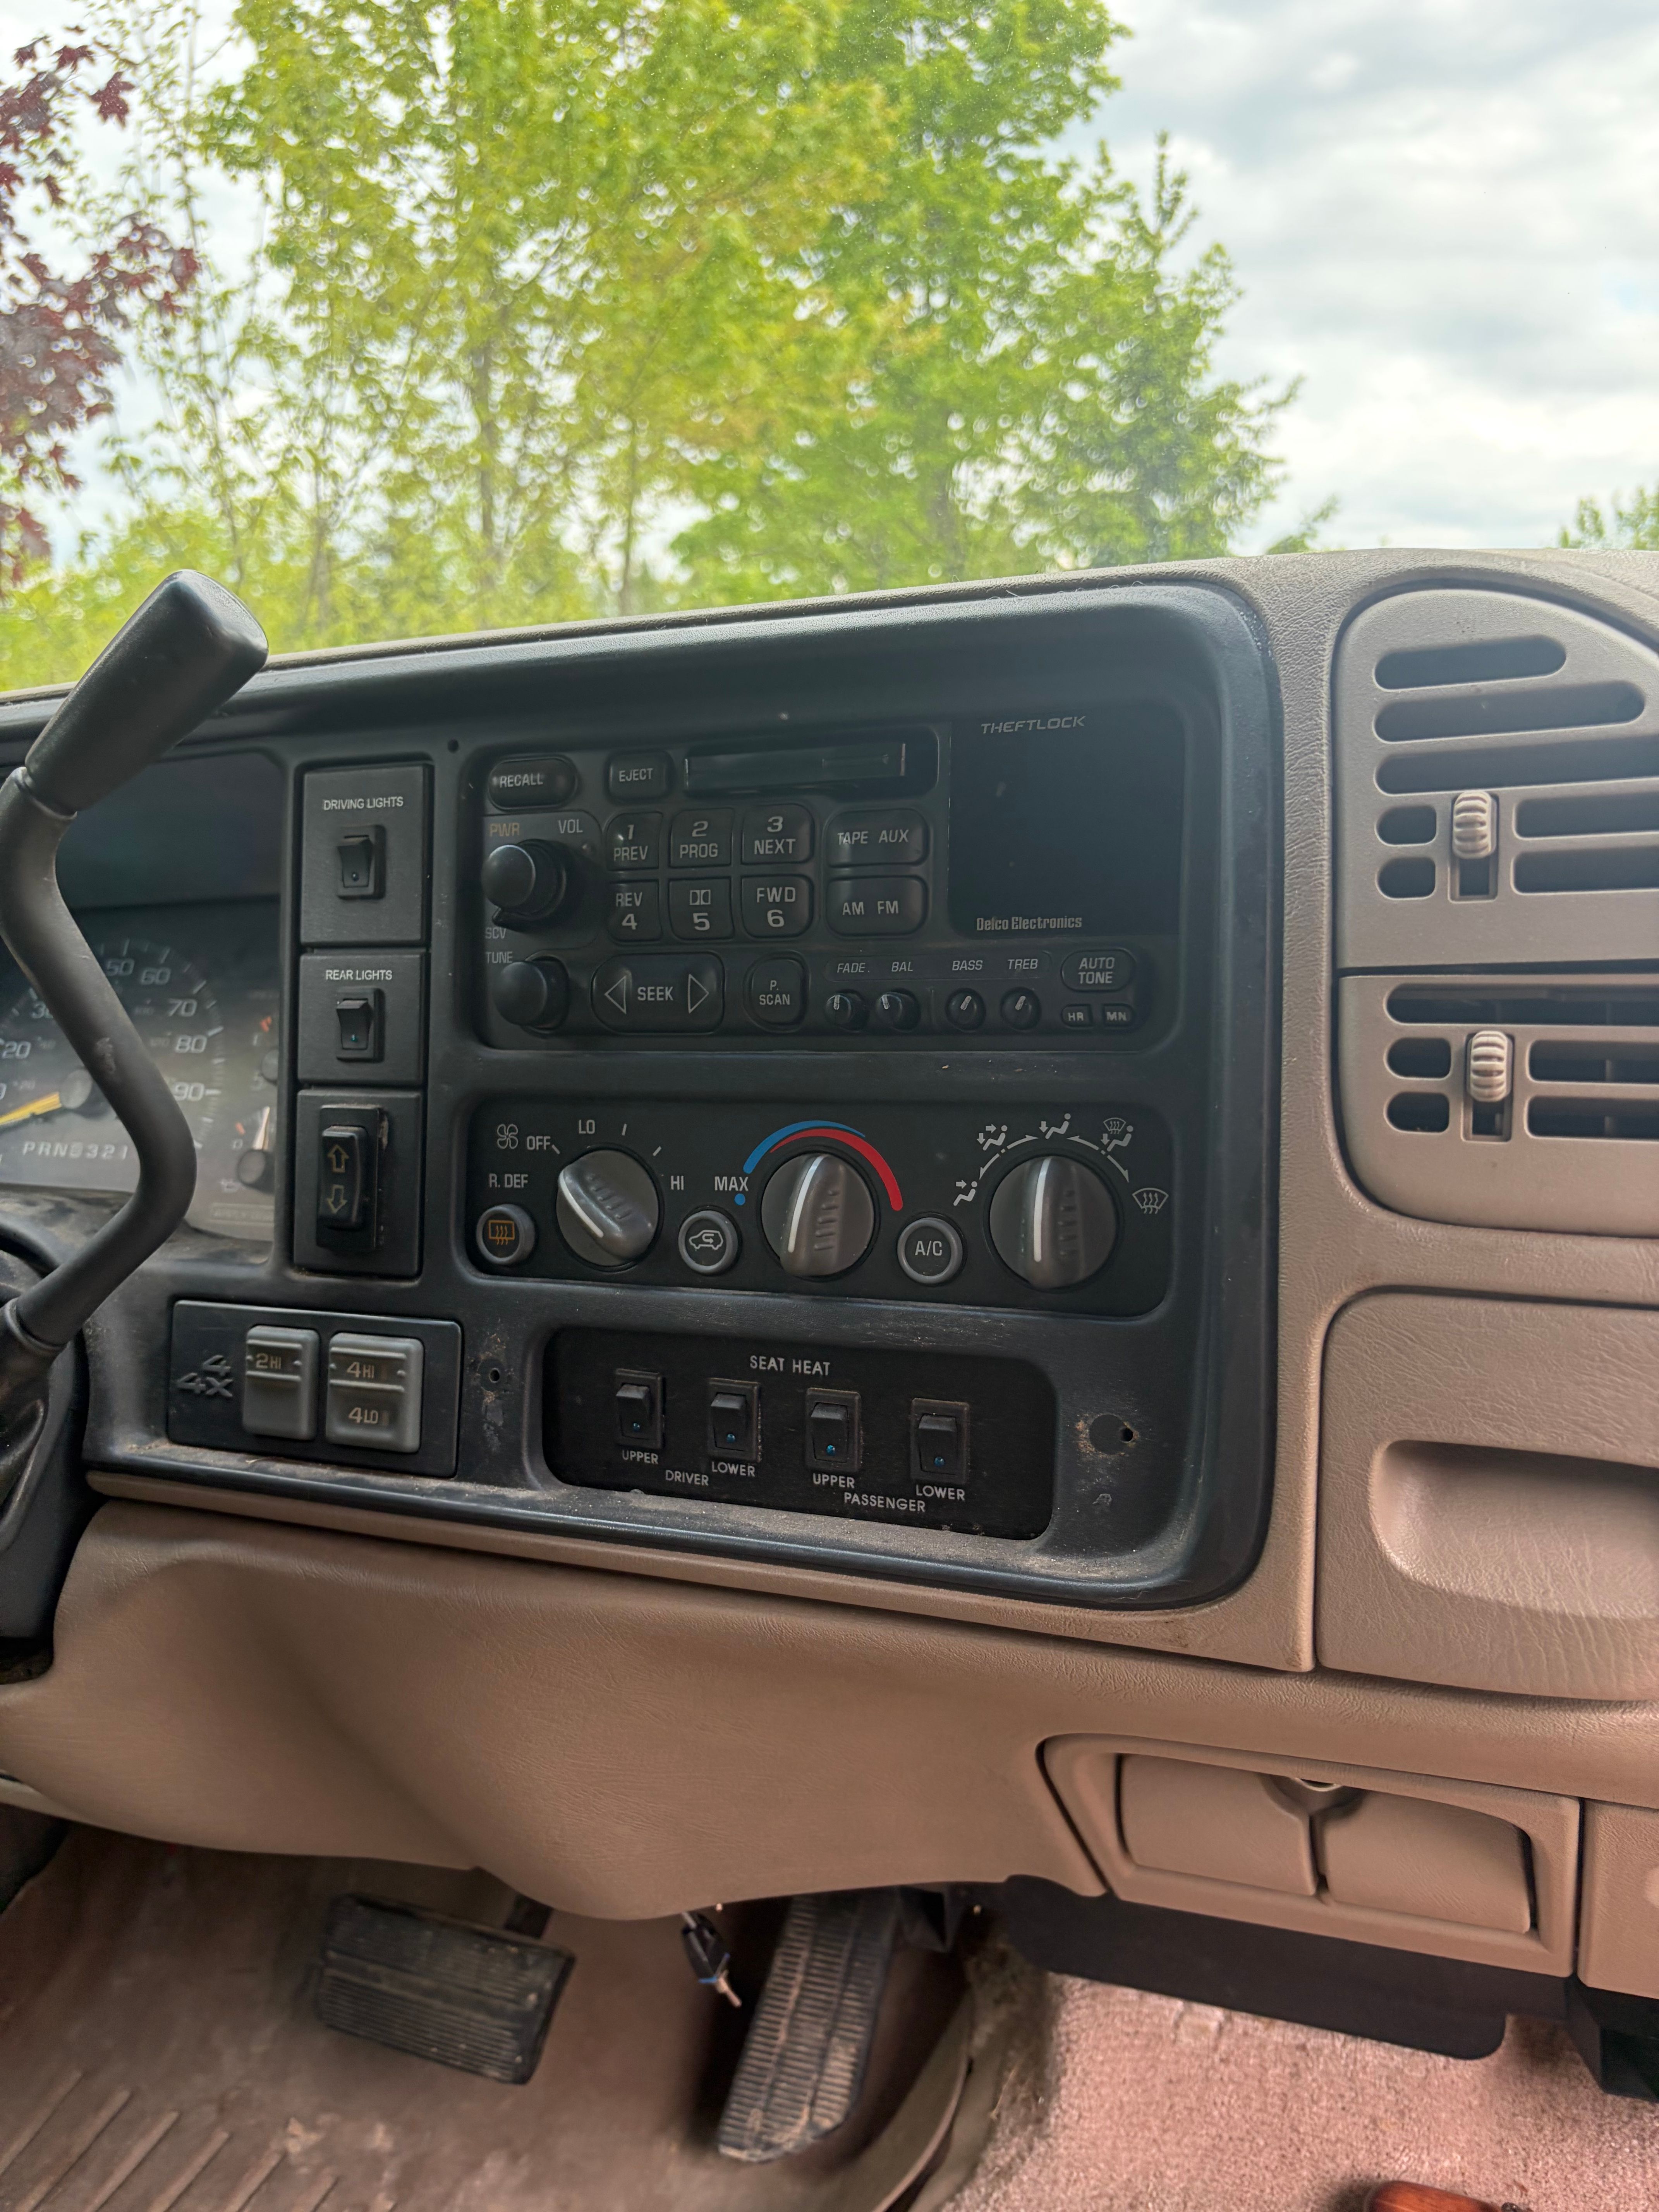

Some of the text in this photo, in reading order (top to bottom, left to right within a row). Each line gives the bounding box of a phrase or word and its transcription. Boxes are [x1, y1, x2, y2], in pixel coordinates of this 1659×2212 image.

[981, 716, 1085, 734] THEFTLOCK
[500, 773, 543, 787] RECALL
[619, 768, 653, 781] EJECT
[323, 796, 404, 810] DRIVING LIGHTS
[490, 823, 520, 836] PWR
[558, 819, 583, 834] VOL
[692, 821, 708, 836] 2
[767, 816, 783, 832] 3
[628, 824, 634, 840] 1
[837, 830, 909, 845] TAPE AUX
[614, 846, 647, 861] PREV
[680, 843, 718, 859] PROG
[754, 839, 795, 854] NEXT
[616, 893, 642, 907] REV
[757, 887, 796, 903] FWD
[842, 900, 899, 915] AM FM
[622, 914, 637, 929] 4
[694, 913, 710, 930] 5
[767, 910, 784, 927] 6
[976, 916, 1082, 931] Delco Electronics
[486, 951, 513, 964] TUNE
[1008, 959, 1038, 969] TREB
[1079, 958, 1115, 969] AUTO
[106, 958, 135, 976] 50
[837, 963, 866, 973] FADE
[891, 962, 913, 972] BAL
[952, 960, 983, 971] BASS
[141, 968, 171, 985] 60
[326, 969, 392, 980] REAR LIGHTS
[1078, 972, 1113, 984] TONE
[637, 986, 673, 1001] SEEK
[759, 994, 790, 1005] SCAN
[168, 998, 198, 1017] 70
[1068, 1012, 1084, 1021] HR
[1106, 1011, 1127, 1021] MN
[2, 1041, 31, 1059] 20
[175, 1035, 208, 1053] 80
[174, 1082, 205, 1101] 90
[578, 1120, 595, 1134] LO
[527, 1136, 551, 1150] OFF
[505, 1174, 528, 1188] DEF
[670, 1176, 684, 1190] HI
[714, 1176, 749, 1192] MAX
[914, 1241, 943, 1256] A/C
[750, 1355, 830, 1376] SEAT HEAT
[622, 1450, 659, 1465] UPPER
[711, 1461, 756, 1477] LOWER
[665, 1470, 709, 1487] DRIVER
[813, 1473, 855, 1489] UPPER
[915, 1484, 965, 1501] LOWER
[844, 1492, 926, 1513] PASSENGER
